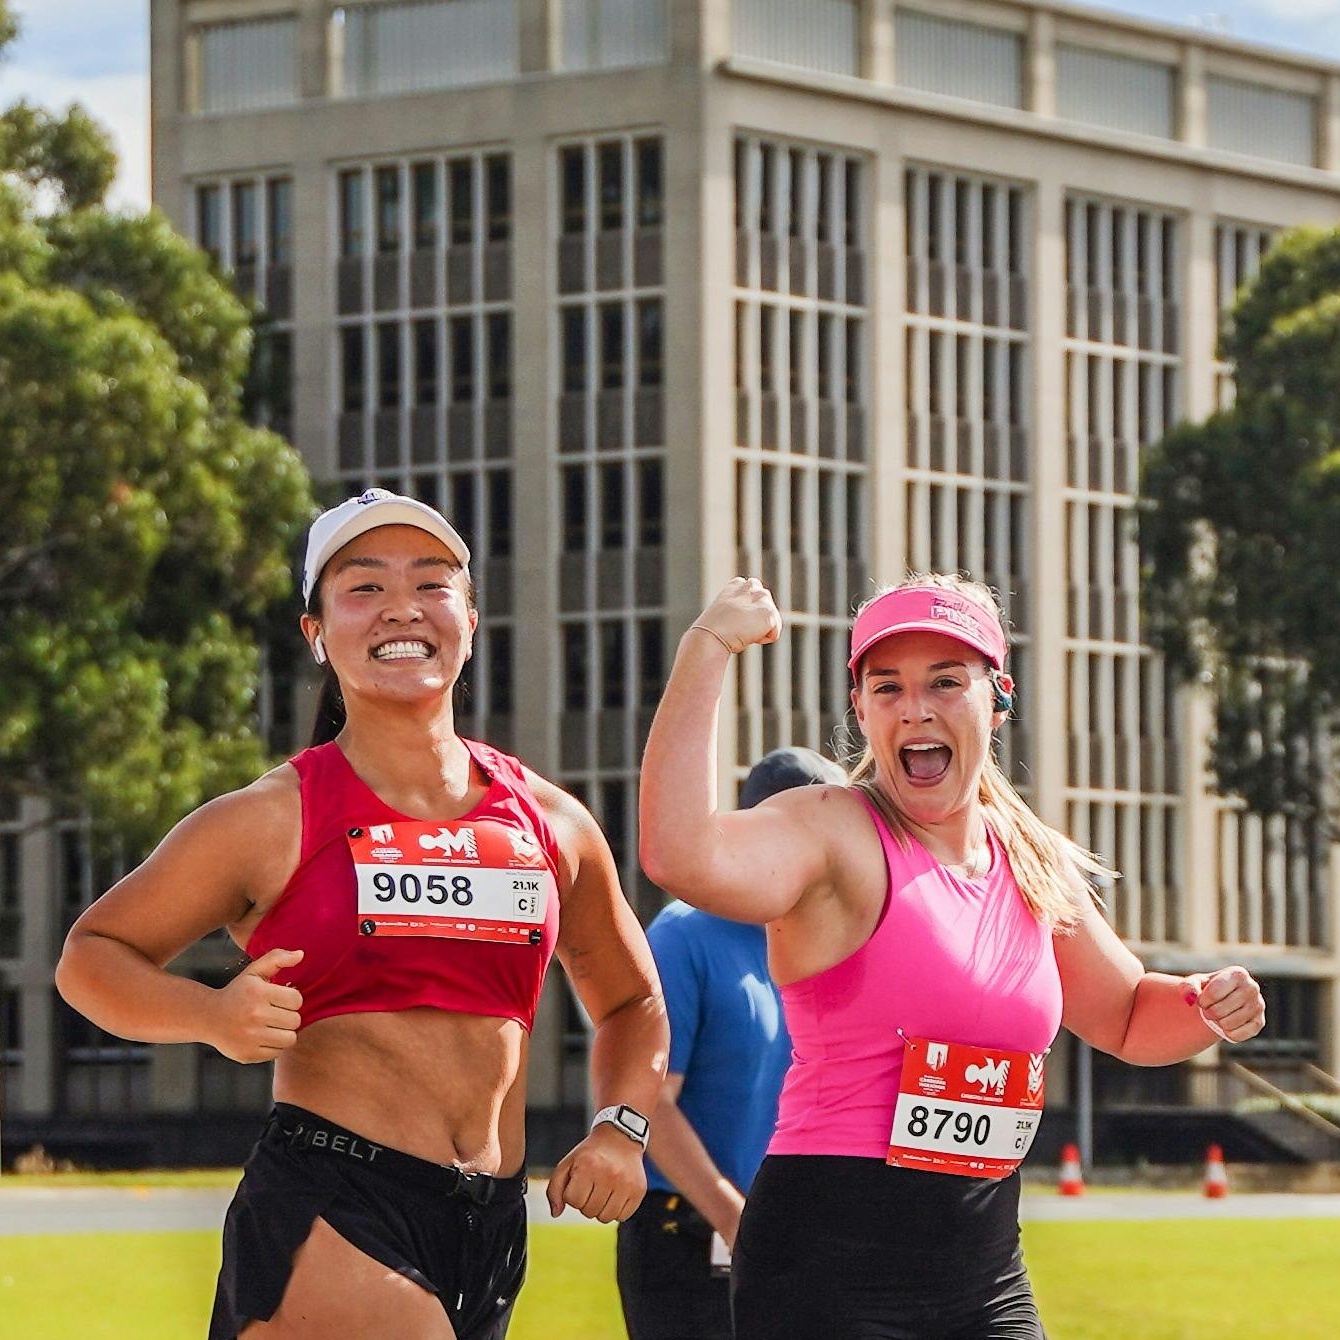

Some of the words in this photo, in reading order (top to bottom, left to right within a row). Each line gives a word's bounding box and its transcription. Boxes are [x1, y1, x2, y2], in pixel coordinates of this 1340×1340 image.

[373, 872, 473, 906] 9058
[512, 880, 539, 891] 21.1K
[518, 898, 527, 911] C
[907, 1105, 991, 1146] 8790
[1015, 1137, 1022, 1149] C
